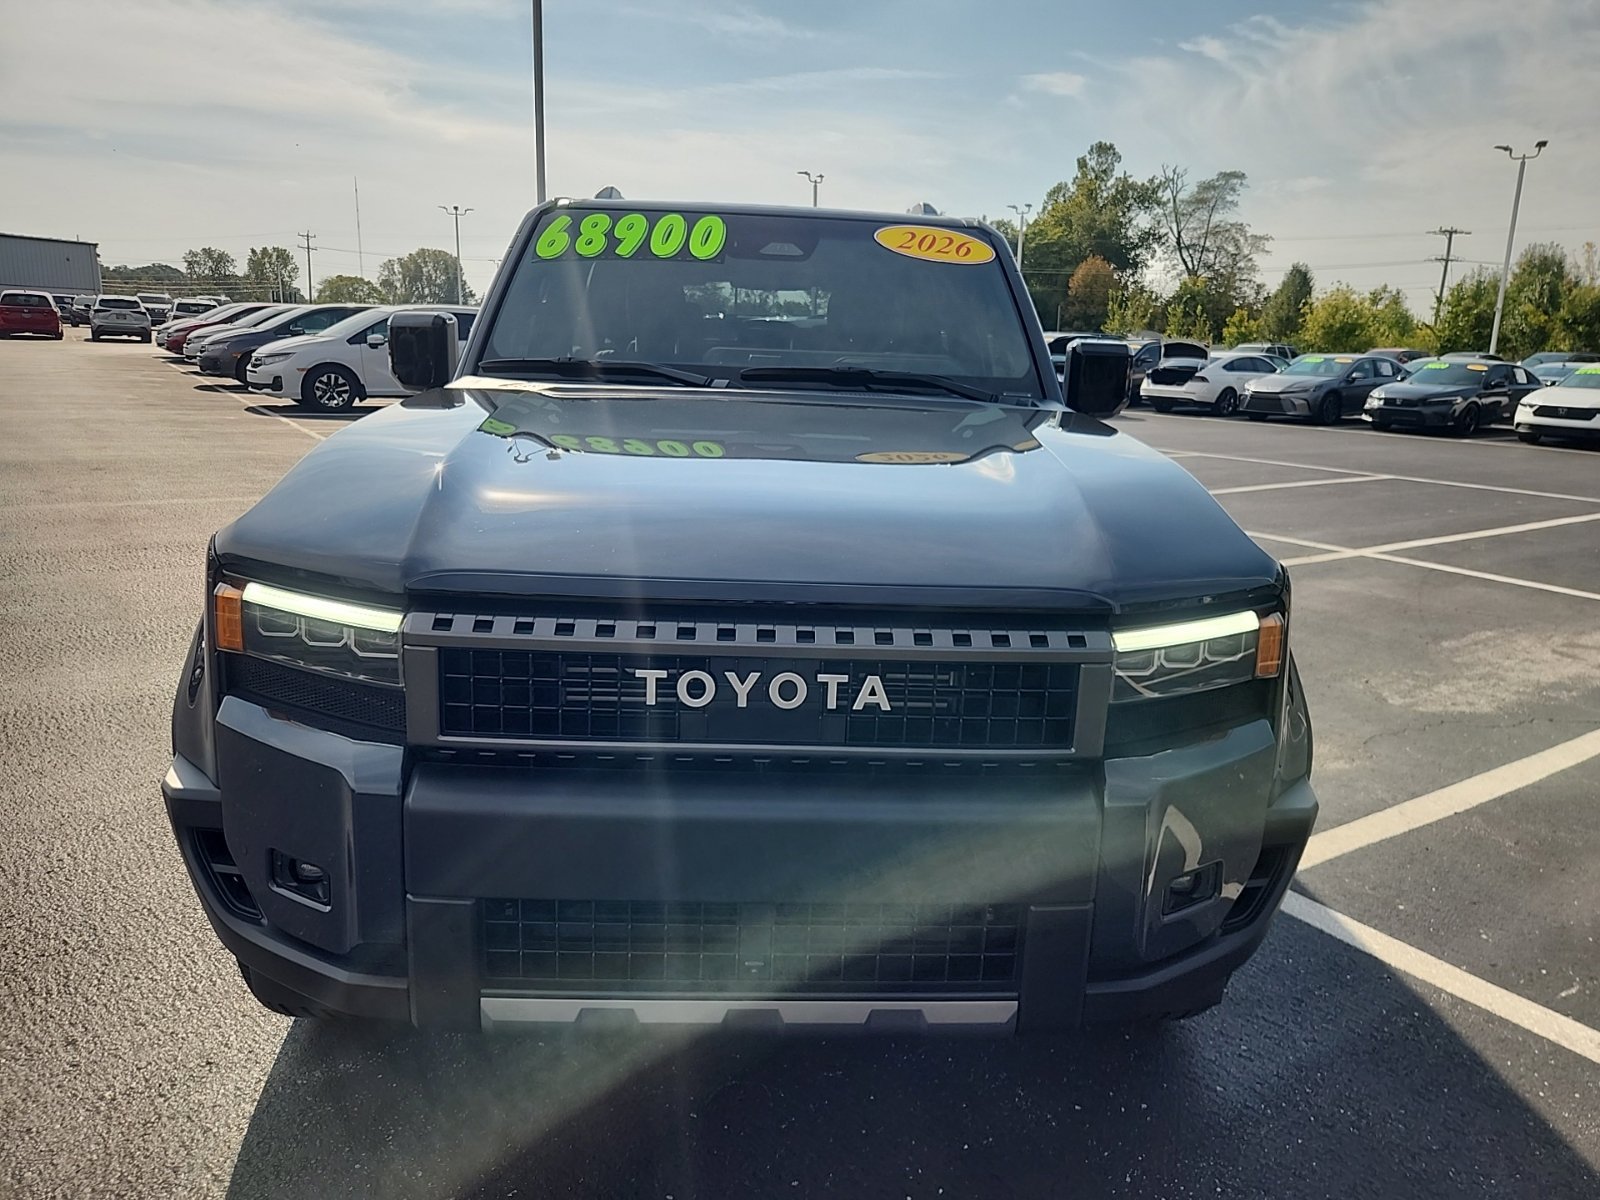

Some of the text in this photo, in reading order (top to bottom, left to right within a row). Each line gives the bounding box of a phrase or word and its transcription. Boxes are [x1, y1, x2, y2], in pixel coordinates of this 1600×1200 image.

[536, 213, 727, 260] 68900
[896, 231, 976, 257] 2026
[635, 669, 891, 711] TOYOTA
